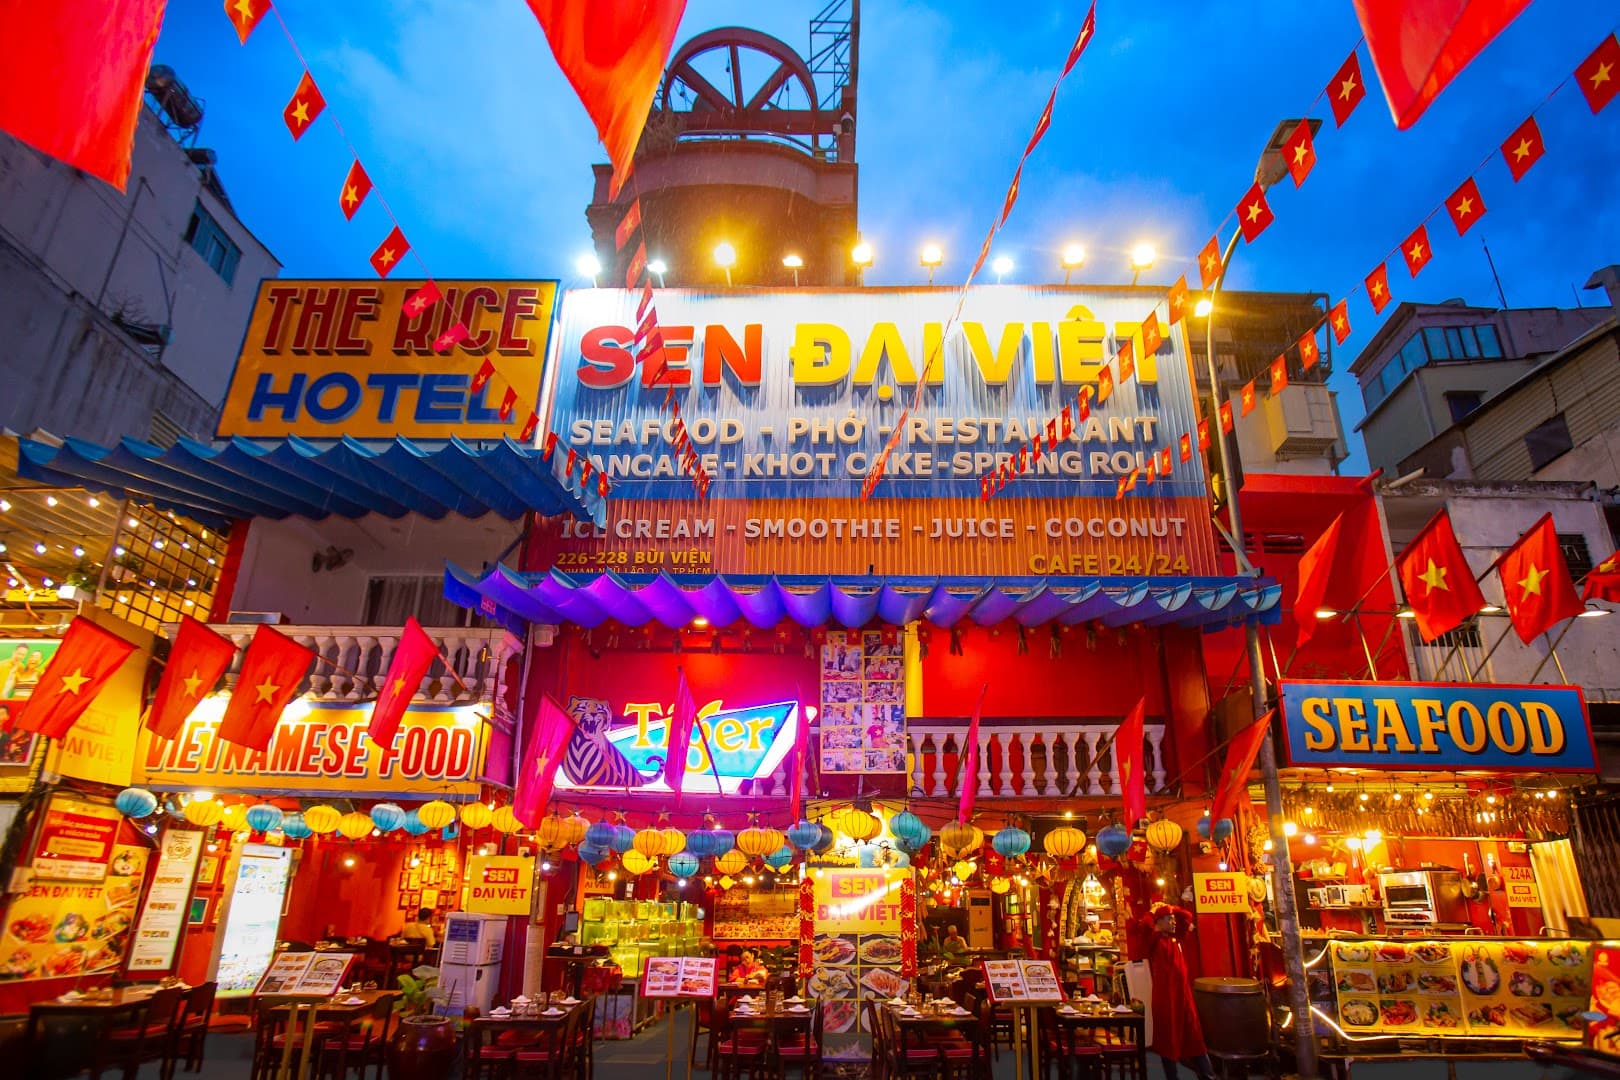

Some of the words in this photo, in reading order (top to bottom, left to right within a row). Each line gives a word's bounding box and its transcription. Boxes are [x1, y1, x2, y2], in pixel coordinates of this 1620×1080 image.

[262, 287, 382, 355] THE
[392, 287, 543, 356] RICE
[577, 324, 763, 389] SEN
[789, 322, 944, 401] ĐẠI
[962, 305, 1170, 400] VIỆT
[247, 372, 516, 423] HOTEL
[570, 418, 744, 445] SEAFOOD
[788, 410, 867, 444] PHỞ
[907, 416, 1158, 443] RESTAURANT
[615, 518, 715, 538] CREAM
[744, 518, 900, 538] SMOOTHIE
[930, 518, 1015, 538] JUICE
[1045, 517, 1186, 537] COCONUT
[556, 551, 628, 565] 226-228
[634, 548, 665, 564] BÙI
[671, 547, 711, 567] VIỆN
[1028, 553, 1099, 575] CAFE
[1109, 553, 1190, 576] 24/24
[1300, 697, 1567, 756] SEAFOOD
[378, 726, 476, 779] FOOD
[487, 870, 515, 881] SEN
[1209, 880, 1232, 890] SEN
[1508, 867, 1532, 880] 224A
[473, 887, 495, 902] ĐẠI
[498, 885, 527, 903] VIỆT
[838, 877, 879, 895] SEN
[858, 900, 900, 926] VIỆT
